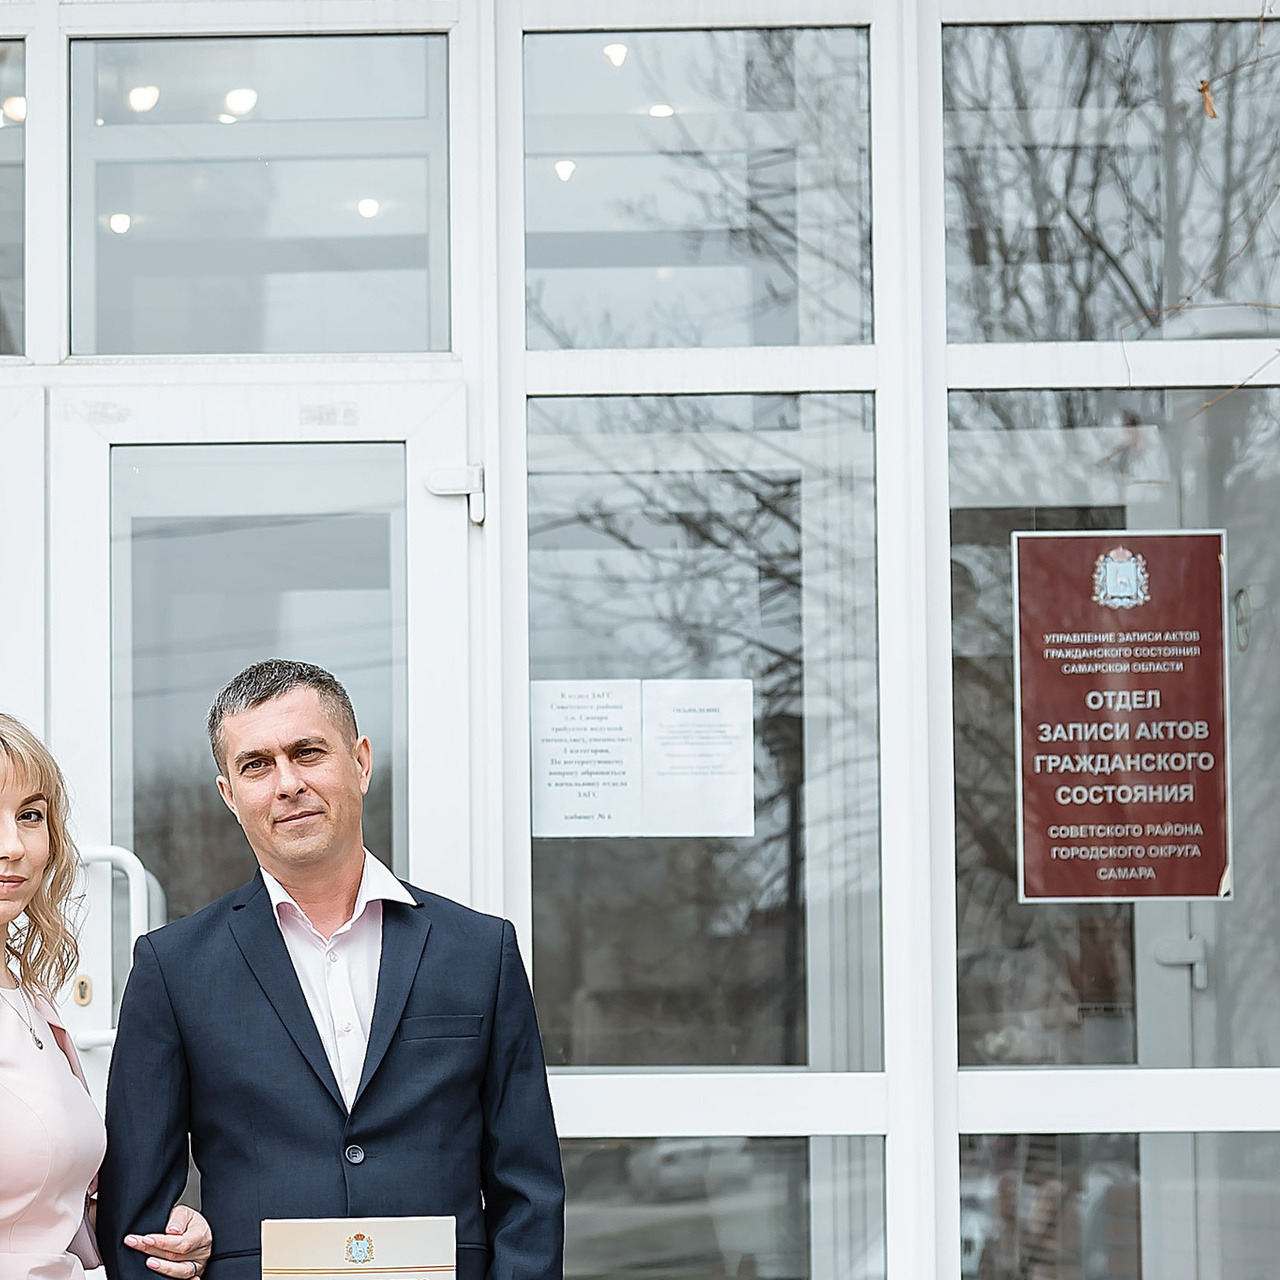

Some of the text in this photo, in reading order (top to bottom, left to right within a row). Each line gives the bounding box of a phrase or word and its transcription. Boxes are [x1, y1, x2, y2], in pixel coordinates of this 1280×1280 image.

[1043, 630, 1200, 645] УПРАВЛЕНИЕ ЗАПИСИ АКТОВ
[1043, 647, 1200, 659] ГРАЖДАНСКОГО СОСТОЯНИЯ
[1132, 662, 1184, 672] ОБЛАСТИ
[1085, 690, 1161, 710] ОТДЕЛ
[1037, 721, 1209, 742] ЗАПИСИ АКТОВ
[1034, 753, 1215, 775] ГРАЖДАНСКОГО
[1055, 785, 1194, 805] СОСТОЯНИЯ
[1048, 821, 1203, 838] СОВЕТСКОГО РАЙОНА
[1051, 846, 1201, 860] ГОРОДСКОГО ОКРУГА
[1096, 867, 1156, 880] САМАРА
